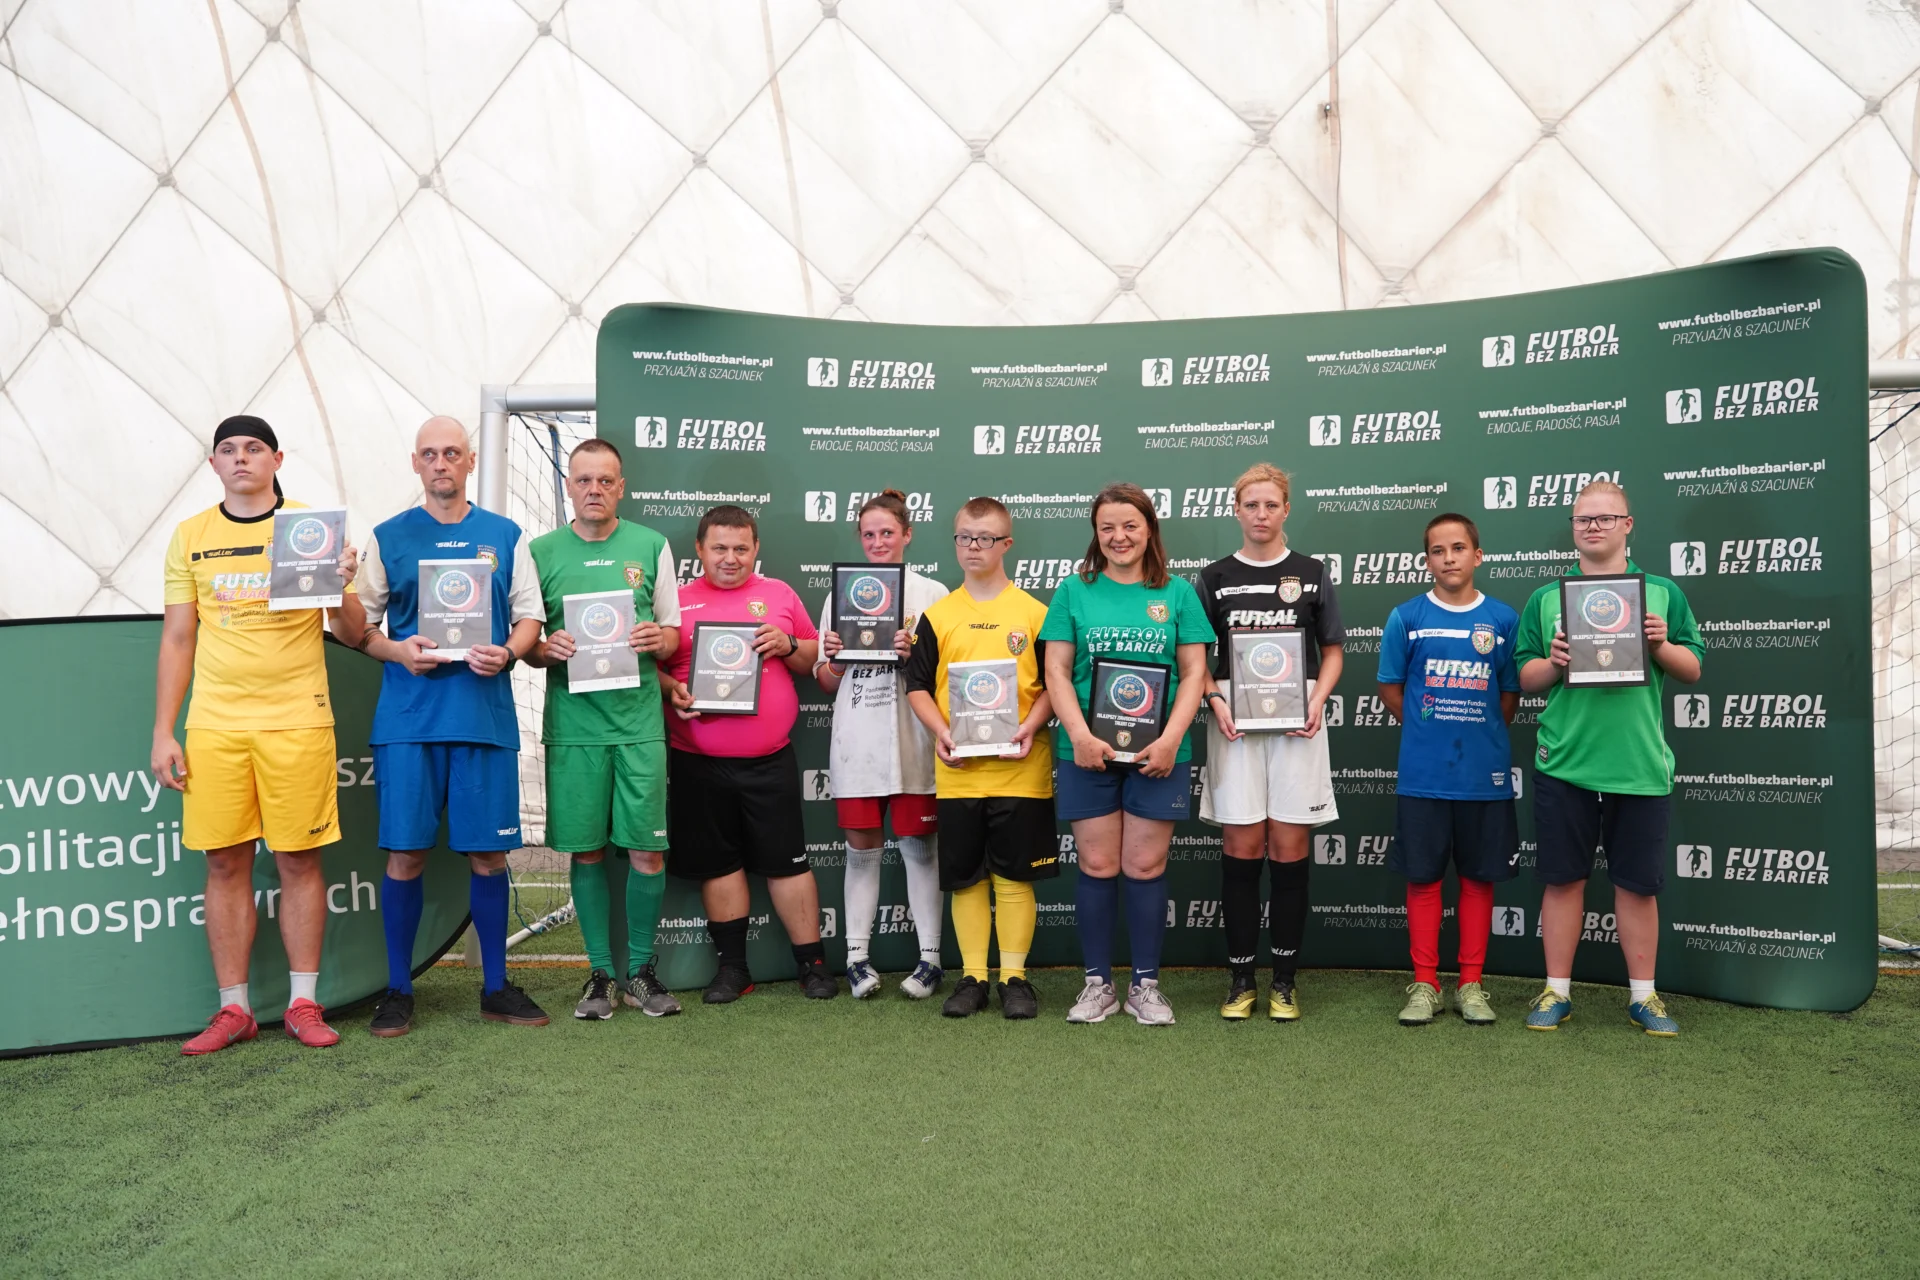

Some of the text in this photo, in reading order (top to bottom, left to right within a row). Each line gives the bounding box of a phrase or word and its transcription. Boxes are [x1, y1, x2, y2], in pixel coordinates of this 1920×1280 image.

[1658, 299, 1821, 329] www.futbolbezbarier.pl
[1527, 324, 1619, 351] FUTBOL
[1672, 317, 1811, 345] PRZYJAŹŃ & SZACUNEK
[632, 351, 773, 368] www.futbolbezbarier.pl
[1306, 344, 1446, 362] www.futbolbezbarier.pl
[1525, 343, 1619, 364] BEZ BARIER
[849, 360, 935, 378] FUTBOL
[971, 362, 1107, 373] www.futbolbezbarier.pl
[1184, 354, 1270, 373] FUTBOL
[1318, 359, 1437, 376] PRZYJAŹŃ & SZACUNEK
[644, 364, 764, 381] PRZYJAŹŃ & SZACUNEK
[1182, 371, 1270, 385] BEZ BARIER
[848, 377, 935, 390] BEZ BARIER
[983, 376, 1098, 387] PRZYJAŹŃ & SZACUNEK
[1715, 377, 1819, 406] FUTBOL
[1478, 398, 1626, 418] www.futbolbezbarier.pl
[1713, 398, 1818, 420] BEZ BARIER
[1137, 420, 1275, 434] www.futbolbezbarier.pl
[1353, 410, 1441, 432] FUTBOL
[1487, 414, 1620, 434] EMOCJE, RADOŚĆ, PASJA
[678, 419, 766, 440] FUTBOL
[802, 426, 940, 438] www.futbolbezbarier.pl
[1016, 424, 1101, 442] FUTBOL
[1351, 429, 1441, 444] BEZ BARIER
[677, 437, 766, 451] BEZ BARIER
[810, 439, 933, 452] EMOCJE, RADOŚĆ, PASJA
[1015, 441, 1101, 454] BEZ BARIER
[1145, 434, 1268, 448] EMOCJE, RADOŚĆ, PASJA
[1663, 459, 1826, 480] www.futbolbezbarier.pl
[1306, 482, 1447, 496] www.futbolbezbarier.pl
[1678, 477, 1815, 497] PRZYJAŹŃ & SZACUNEK
[631, 490, 771, 504] www.futbolbezbarier.pl
[1528, 494, 1556, 507] BEZ
[643, 503, 697, 517] PRZYJAŹŃ
[696, 506, 705, 517] &
[1181, 506, 1209, 518] BEZ
[1318, 498, 1438, 512] PRZYJAŹŃ & SZACUNEK
[1034, 508, 1041, 518] &
[1720, 537, 1822, 560] FUTBOL
[1354, 553, 1428, 572] FUTBO
[1718, 558, 1822, 574] BEZ BARIER
[1352, 572, 1381, 584] BEZ
[1490, 566, 1536, 578] EMOCJE,
[1015, 577, 1041, 589] BEZ
[1228, 609, 1296, 626] FUTSAL
[1087, 627, 1166, 644] FUTBOL
[1743, 635, 1820, 648] & SZACUNEK
[1088, 642, 1164, 654] BEZ BARIER
[852, 669, 873, 679] BEZ
[1426, 659, 1491, 679] FUTSAL
[1425, 676, 1488, 691] BEZ BARIER
[1723, 694, 1826, 715] FUTBOL
[1354, 714, 1383, 726] BEZ
[1721, 715, 1826, 728] BEZ BARIER
[1685, 788, 1824, 804] PRZYJAŹŃ & SZACUNEK
[1357, 853, 1385, 865] BEZ
[1726, 847, 1829, 871] FUTBOL
[1724, 867, 1829, 885] BEZ BARIER
[1312, 904, 1454, 916] www.futbolbezb.pl
[1186, 918, 1213, 928] BEZ
[1324, 917, 1378, 928] PRZYJAŹŃ
[695, 933, 703, 943] &
[1673, 922, 1835, 944] www.futbolbezbarier.pl
[1686, 937, 1825, 960] PRZYJAŹŃ & SZACUNEK
